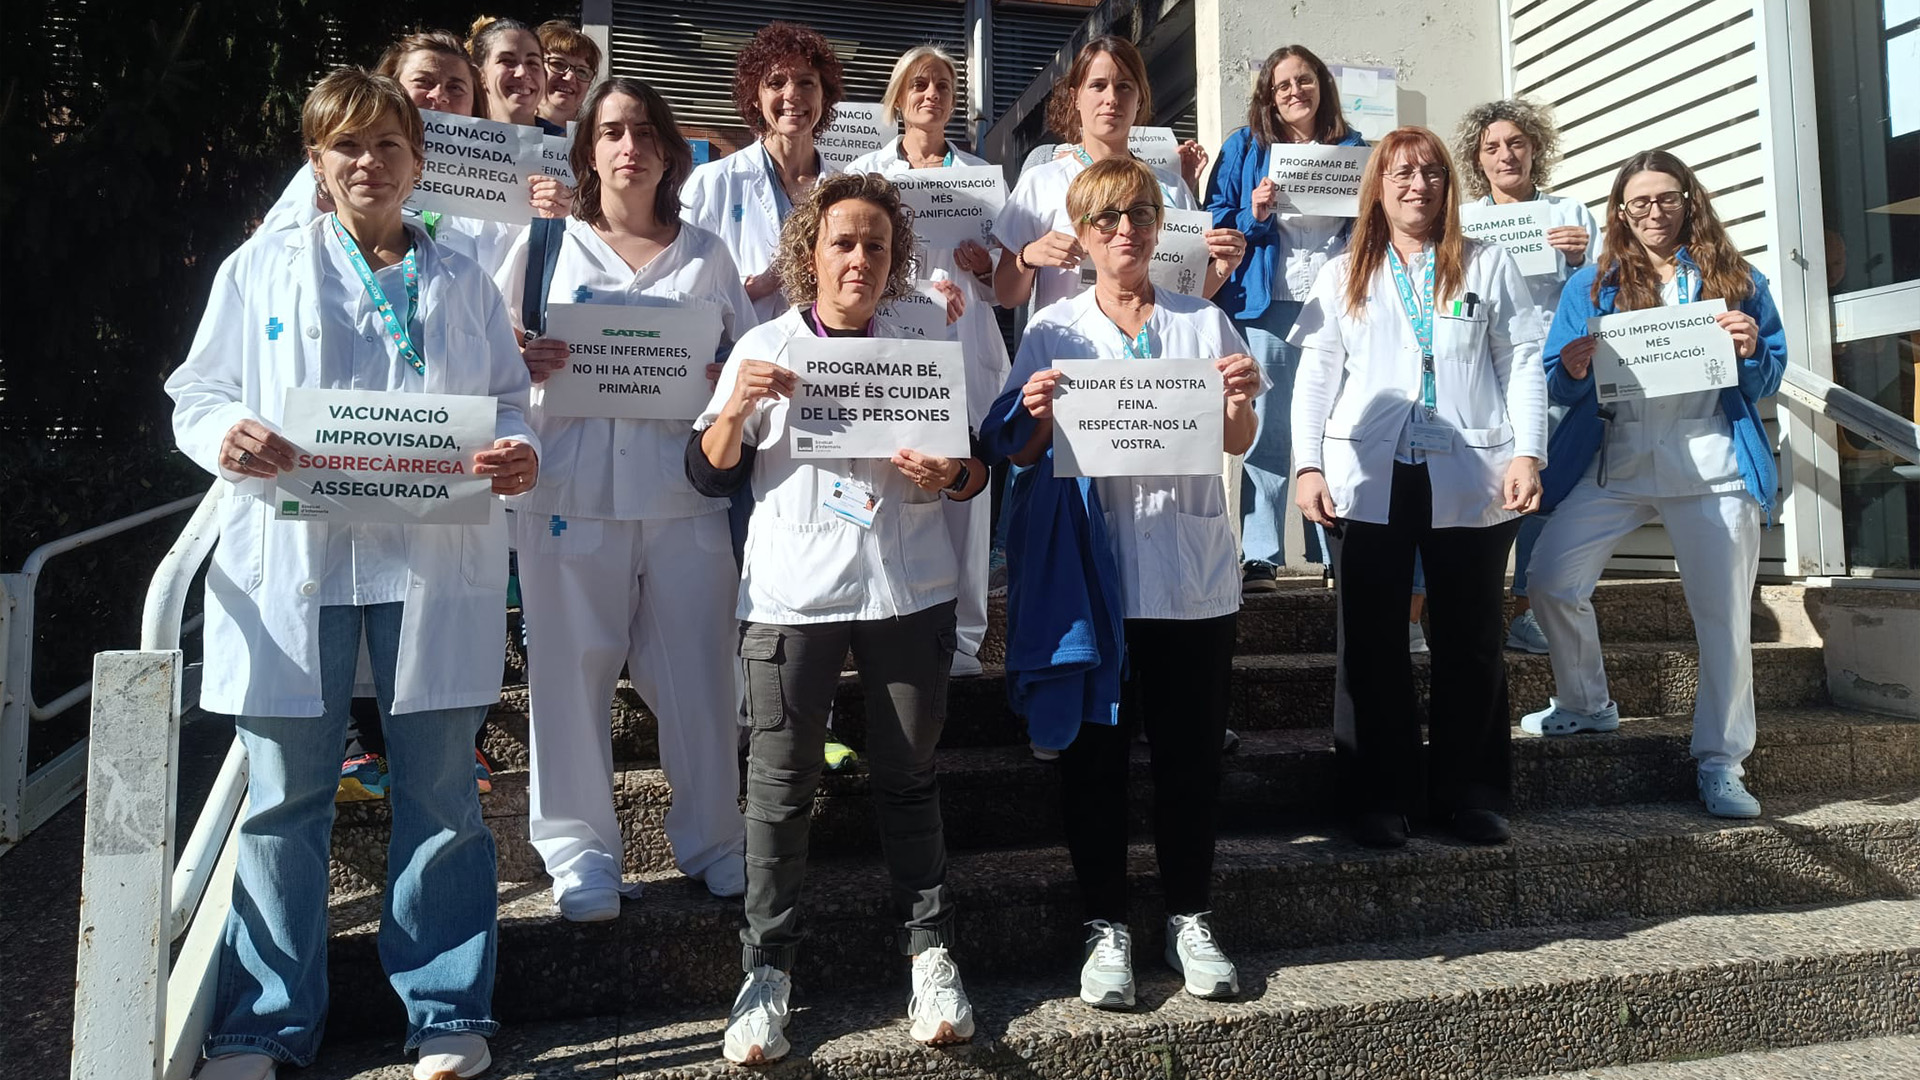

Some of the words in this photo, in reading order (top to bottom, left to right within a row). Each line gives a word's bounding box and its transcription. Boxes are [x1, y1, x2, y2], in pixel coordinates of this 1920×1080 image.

[422, 122, 506, 143] ACUNACIÓ
[828, 124, 880, 136] OVISADA,
[813, 137, 882, 150] BRECÀRREGA
[424, 141, 516, 166] PROVISADA,
[557, 152, 568, 161] LA
[1280, 158, 1342, 169] PROGRAMAR
[1344, 160, 1359, 170] BÉ,
[423, 160, 518, 184] RECÀRREGA
[1276, 171, 1309, 180] TAMBÉ
[1311, 171, 1323, 181] ÉS
[1325, 173, 1361, 183] CUIDAR
[917, 178, 996, 189] IMPROVISACIÓ!
[1274, 184, 1286, 192] DE
[1288, 185, 1305, 193] LES
[1307, 186, 1358, 196] PERSONES
[413, 181, 506, 202] SSEGURADA
[931, 193, 953, 203] MÉS
[1163, 222, 1203, 235] ISACIÓ!
[1461, 218, 1515, 233] OGRAMAR
[1500, 229, 1543, 242] CUIDAR
[1505, 243, 1543, 255] SONES
[602, 328, 661, 338] SATSE
[1593, 328, 1627, 340] PROU
[1645, 336, 1670, 348] MÉS
[569, 343, 607, 354] SENSE
[611, 345, 690, 359] INFERMERES,
[1618, 346, 1705, 367] PLANIFICACIÓ!
[572, 364, 592, 374] NO
[595, 364, 608, 375] HI
[612, 365, 630, 375] HA
[633, 365, 687, 377] ATENCIÓ
[806, 361, 912, 377] PROGRAMAR
[917, 361, 942, 379] BÉ,
[599, 382, 661, 394] PRIMÀRIA
[1068, 379, 1116, 390] CUIDAR
[1120, 376, 1134, 390] ÉS
[1137, 379, 1152, 389] LA
[1155, 379, 1206, 390] NOSTRA
[802, 382, 860, 398] TAMBÉ
[864, 382, 884, 399] ÉS
[888, 386, 950, 400] CUIDAR
[1117, 399, 1158, 410] FEINA.
[329, 405, 449, 424] VACUNACIÓ
[800, 407, 823, 420] DE
[827, 408, 858, 421] LES
[862, 408, 950, 422] PERSONES
[1078, 419, 1179, 430] RESPECTAR-NOS
[1183, 420, 1197, 430] LA
[315, 429, 461, 452] IMPROVISADA,
[1111, 438, 1165, 450] VOSTRA.
[298, 454, 465, 475] SOBRECÀRREGA
[311, 481, 449, 499] ASSEGURADA
